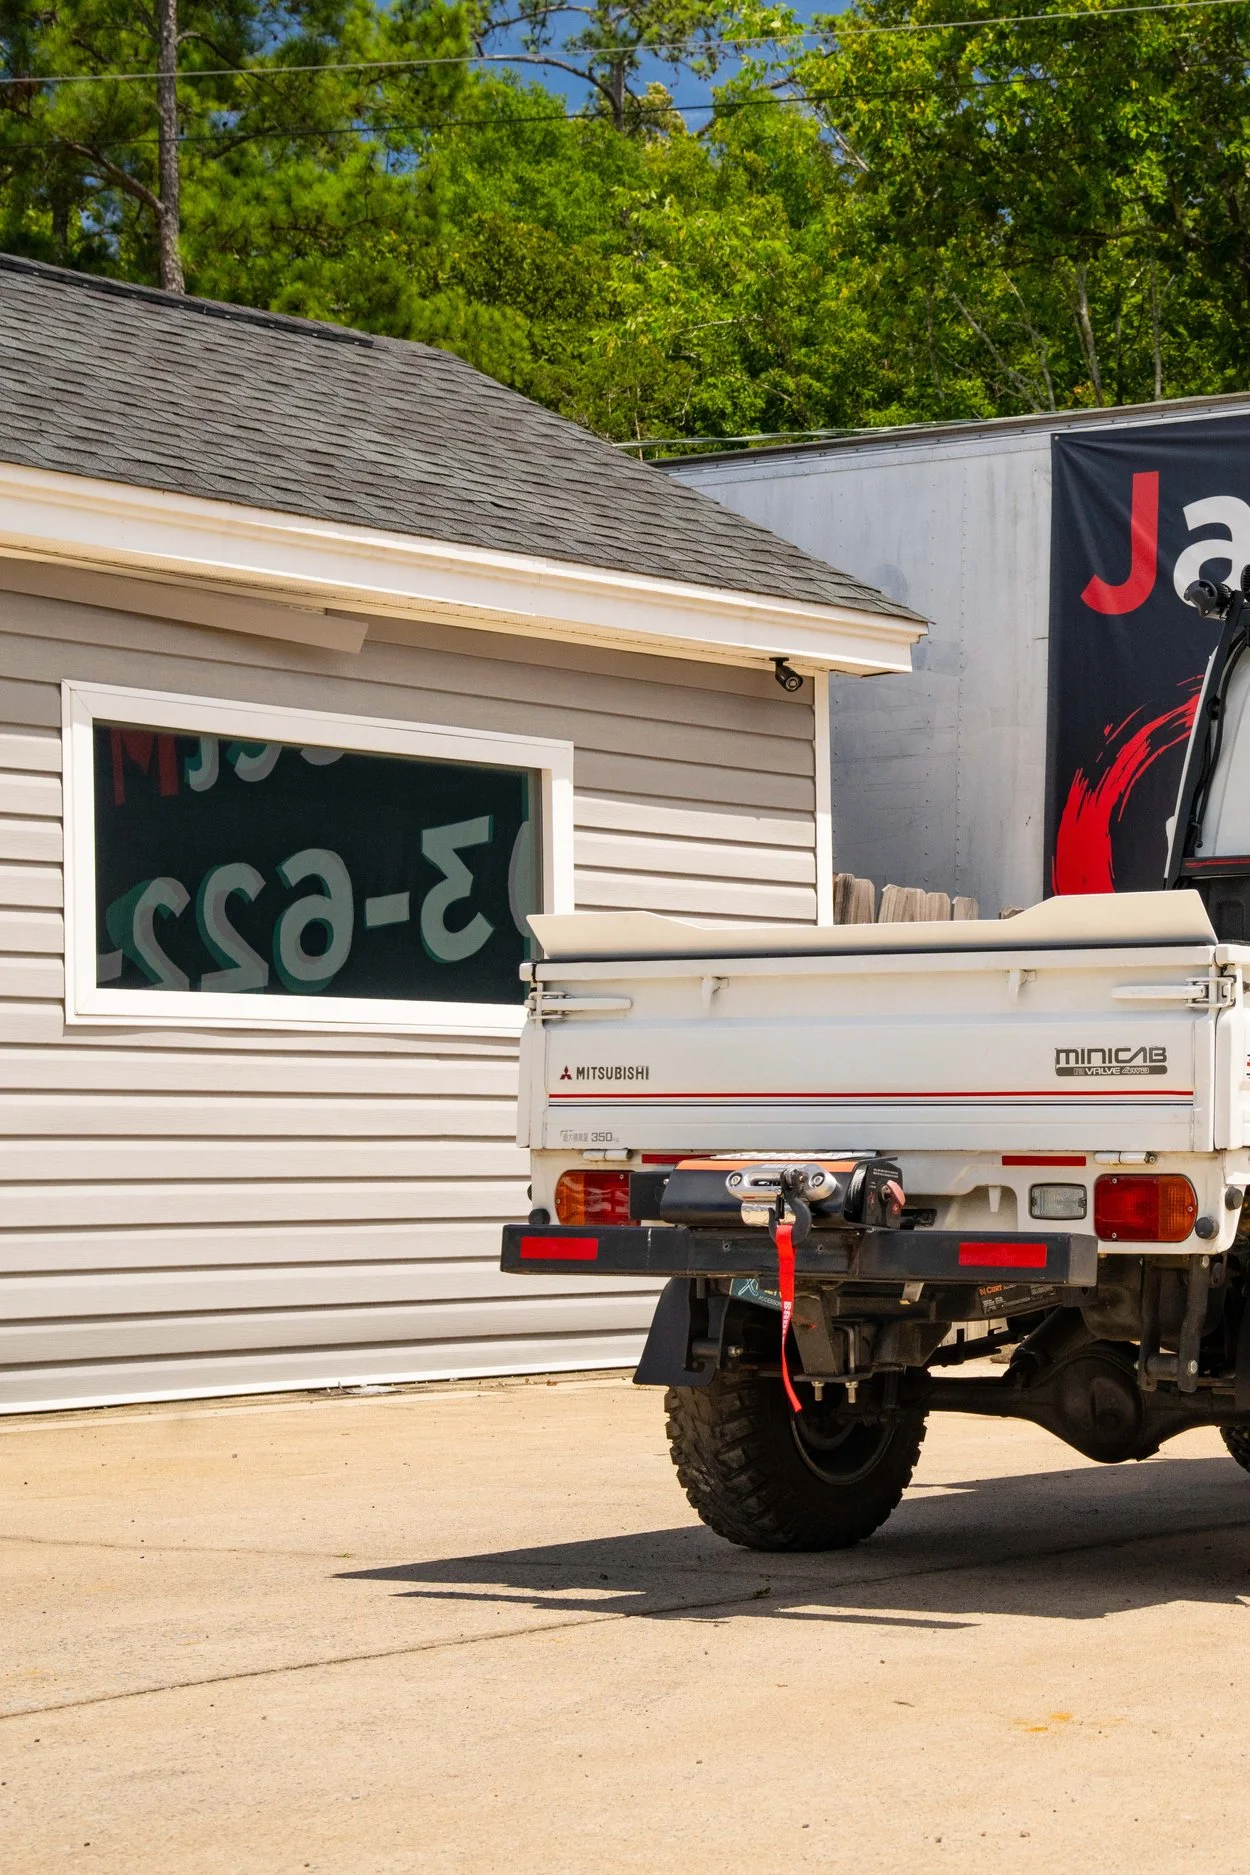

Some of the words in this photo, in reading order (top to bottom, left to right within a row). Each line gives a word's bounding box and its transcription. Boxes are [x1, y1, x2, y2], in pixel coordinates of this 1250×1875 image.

[1055, 1046, 1167, 1065] MINICAB
[576, 1066, 649, 1080] MITSUBISHI
[1085, 1066, 1121, 1075] VALVE
